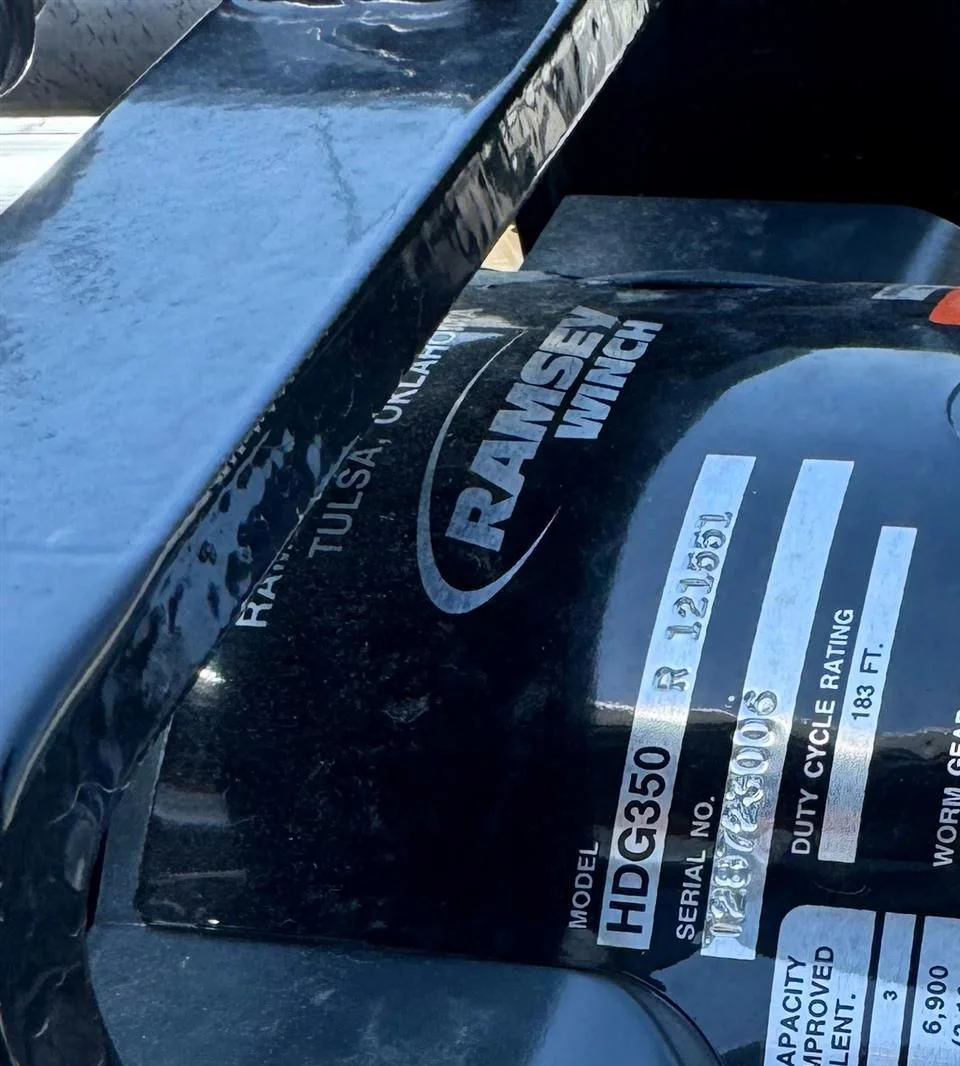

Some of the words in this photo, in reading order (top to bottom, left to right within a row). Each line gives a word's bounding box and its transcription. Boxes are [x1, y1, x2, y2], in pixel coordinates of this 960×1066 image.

[554, 319, 664, 440] WINCH
[445, 306, 625, 552] RAMSEY
[307, 438, 392, 558] TULSA,
[665, 511, 733, 641] 121551
[652, 667, 690, 693] R
[820, 608, 855, 691] RATING
[859, 642, 885, 675] FT.
[803, 698, 836, 779] CYCLE
[851, 683, 876, 722] 183
[605, 745, 671, 935] HDG350
[689, 795, 715, 837] NO.
[791, 789, 819, 855] DUTY
[569, 841, 599, 929] MODEL
[676, 846, 706, 941] SERIAL
[883, 990, 898, 1001] 3
[923, 965, 949, 1035] 6,900
